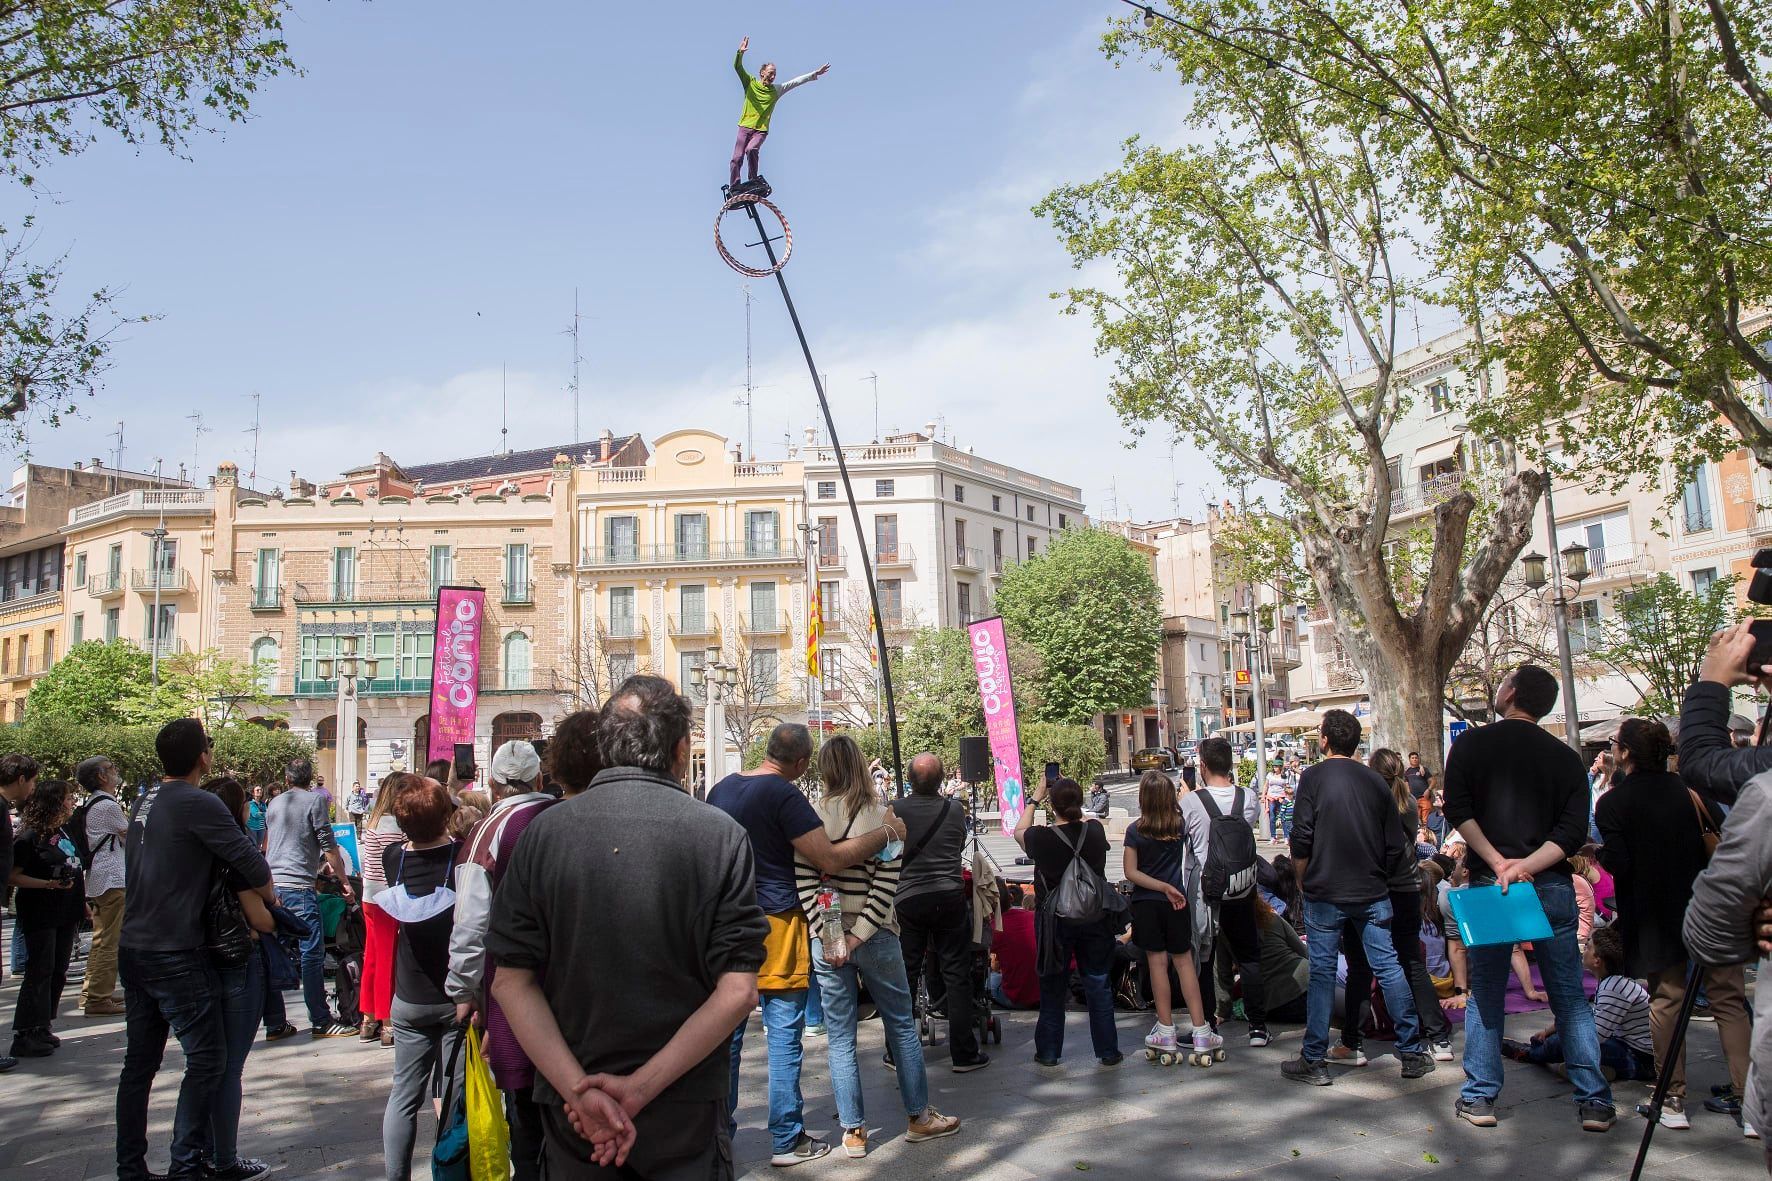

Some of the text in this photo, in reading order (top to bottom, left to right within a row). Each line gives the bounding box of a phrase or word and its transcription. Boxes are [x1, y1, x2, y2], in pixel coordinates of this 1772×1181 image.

[438, 628, 454, 684] Festival
[1450, 728, 1467, 737] TA
[1228, 861, 1257, 894] NIK
